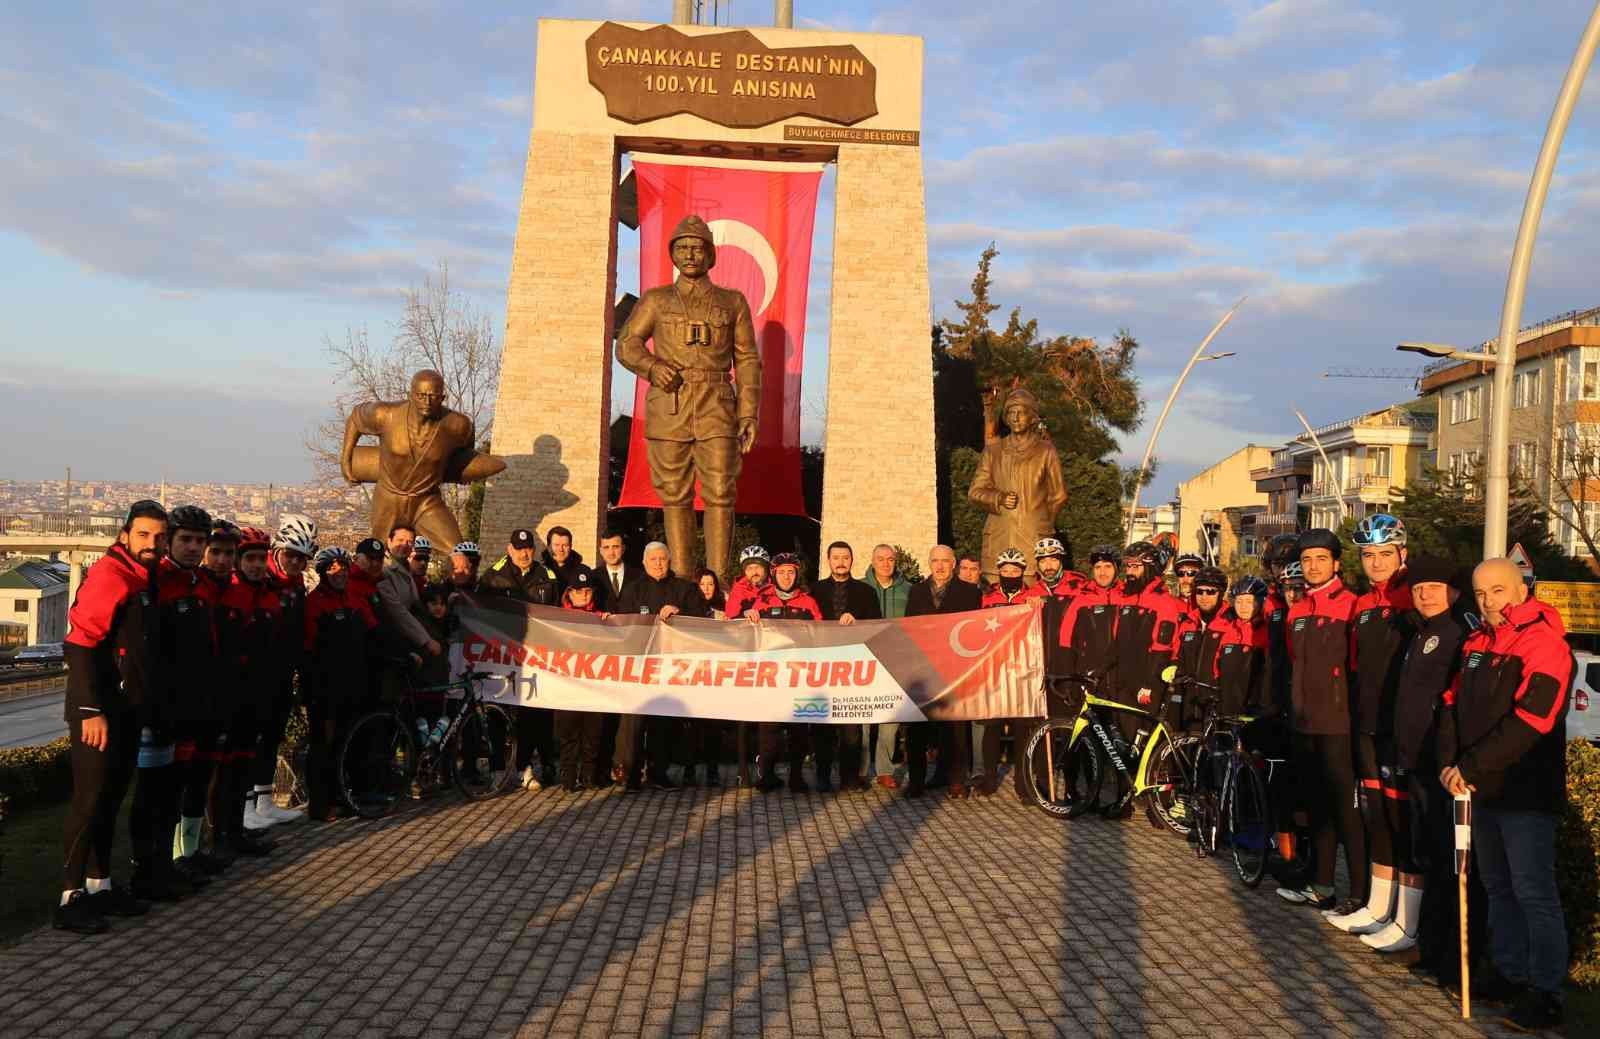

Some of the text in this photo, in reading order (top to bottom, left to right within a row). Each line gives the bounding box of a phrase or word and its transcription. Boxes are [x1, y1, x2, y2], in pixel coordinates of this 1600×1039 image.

[597, 46, 865, 77] ÇANAKKALE DESTANI'NIN
[643, 75, 817, 99] 100.YIL ANISINA
[463, 632, 877, 688] ÇANAKKALE ZAFER TURU
[1093, 724, 1127, 770] CIPOLLINI
